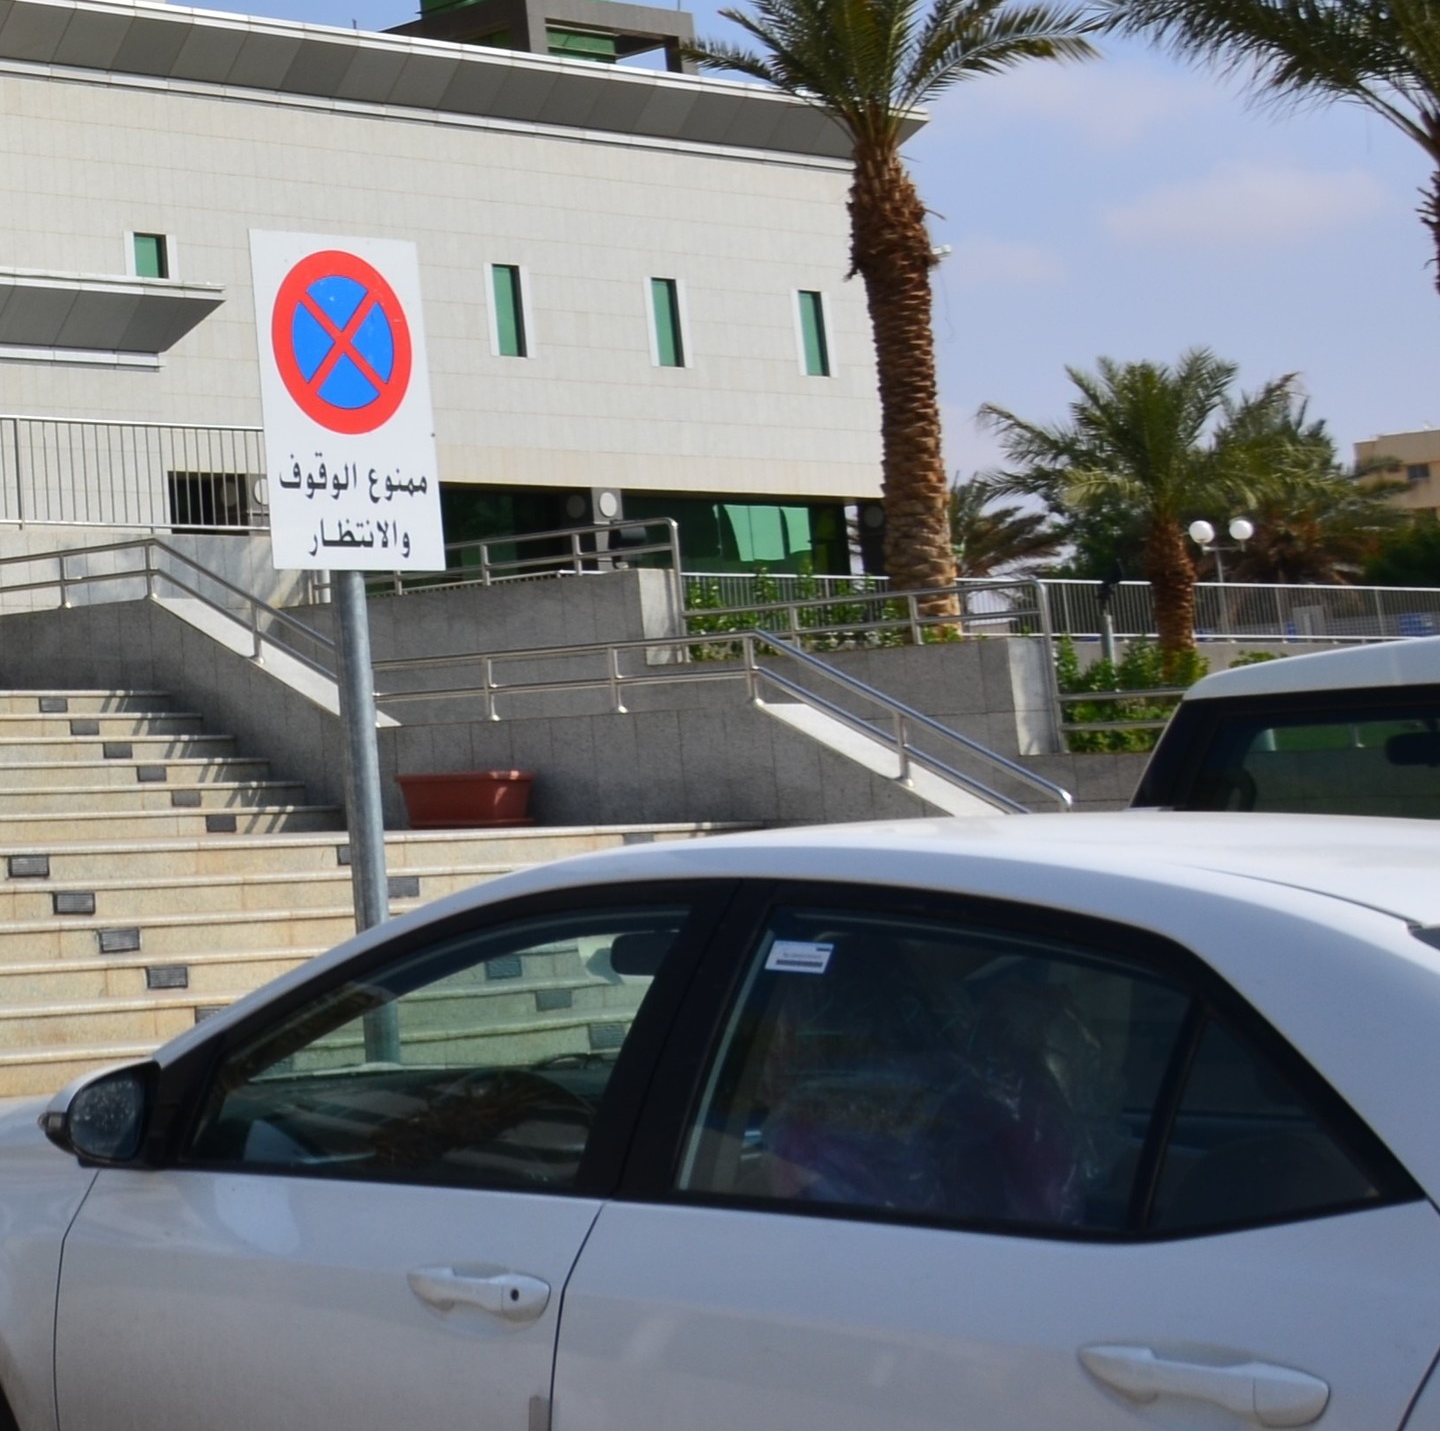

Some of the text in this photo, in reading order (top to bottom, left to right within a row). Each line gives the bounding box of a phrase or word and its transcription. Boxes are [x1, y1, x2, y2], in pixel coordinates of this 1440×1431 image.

[279, 451, 428, 504] ممنوع الوقوف
[308, 517, 411, 559] والانتظار
